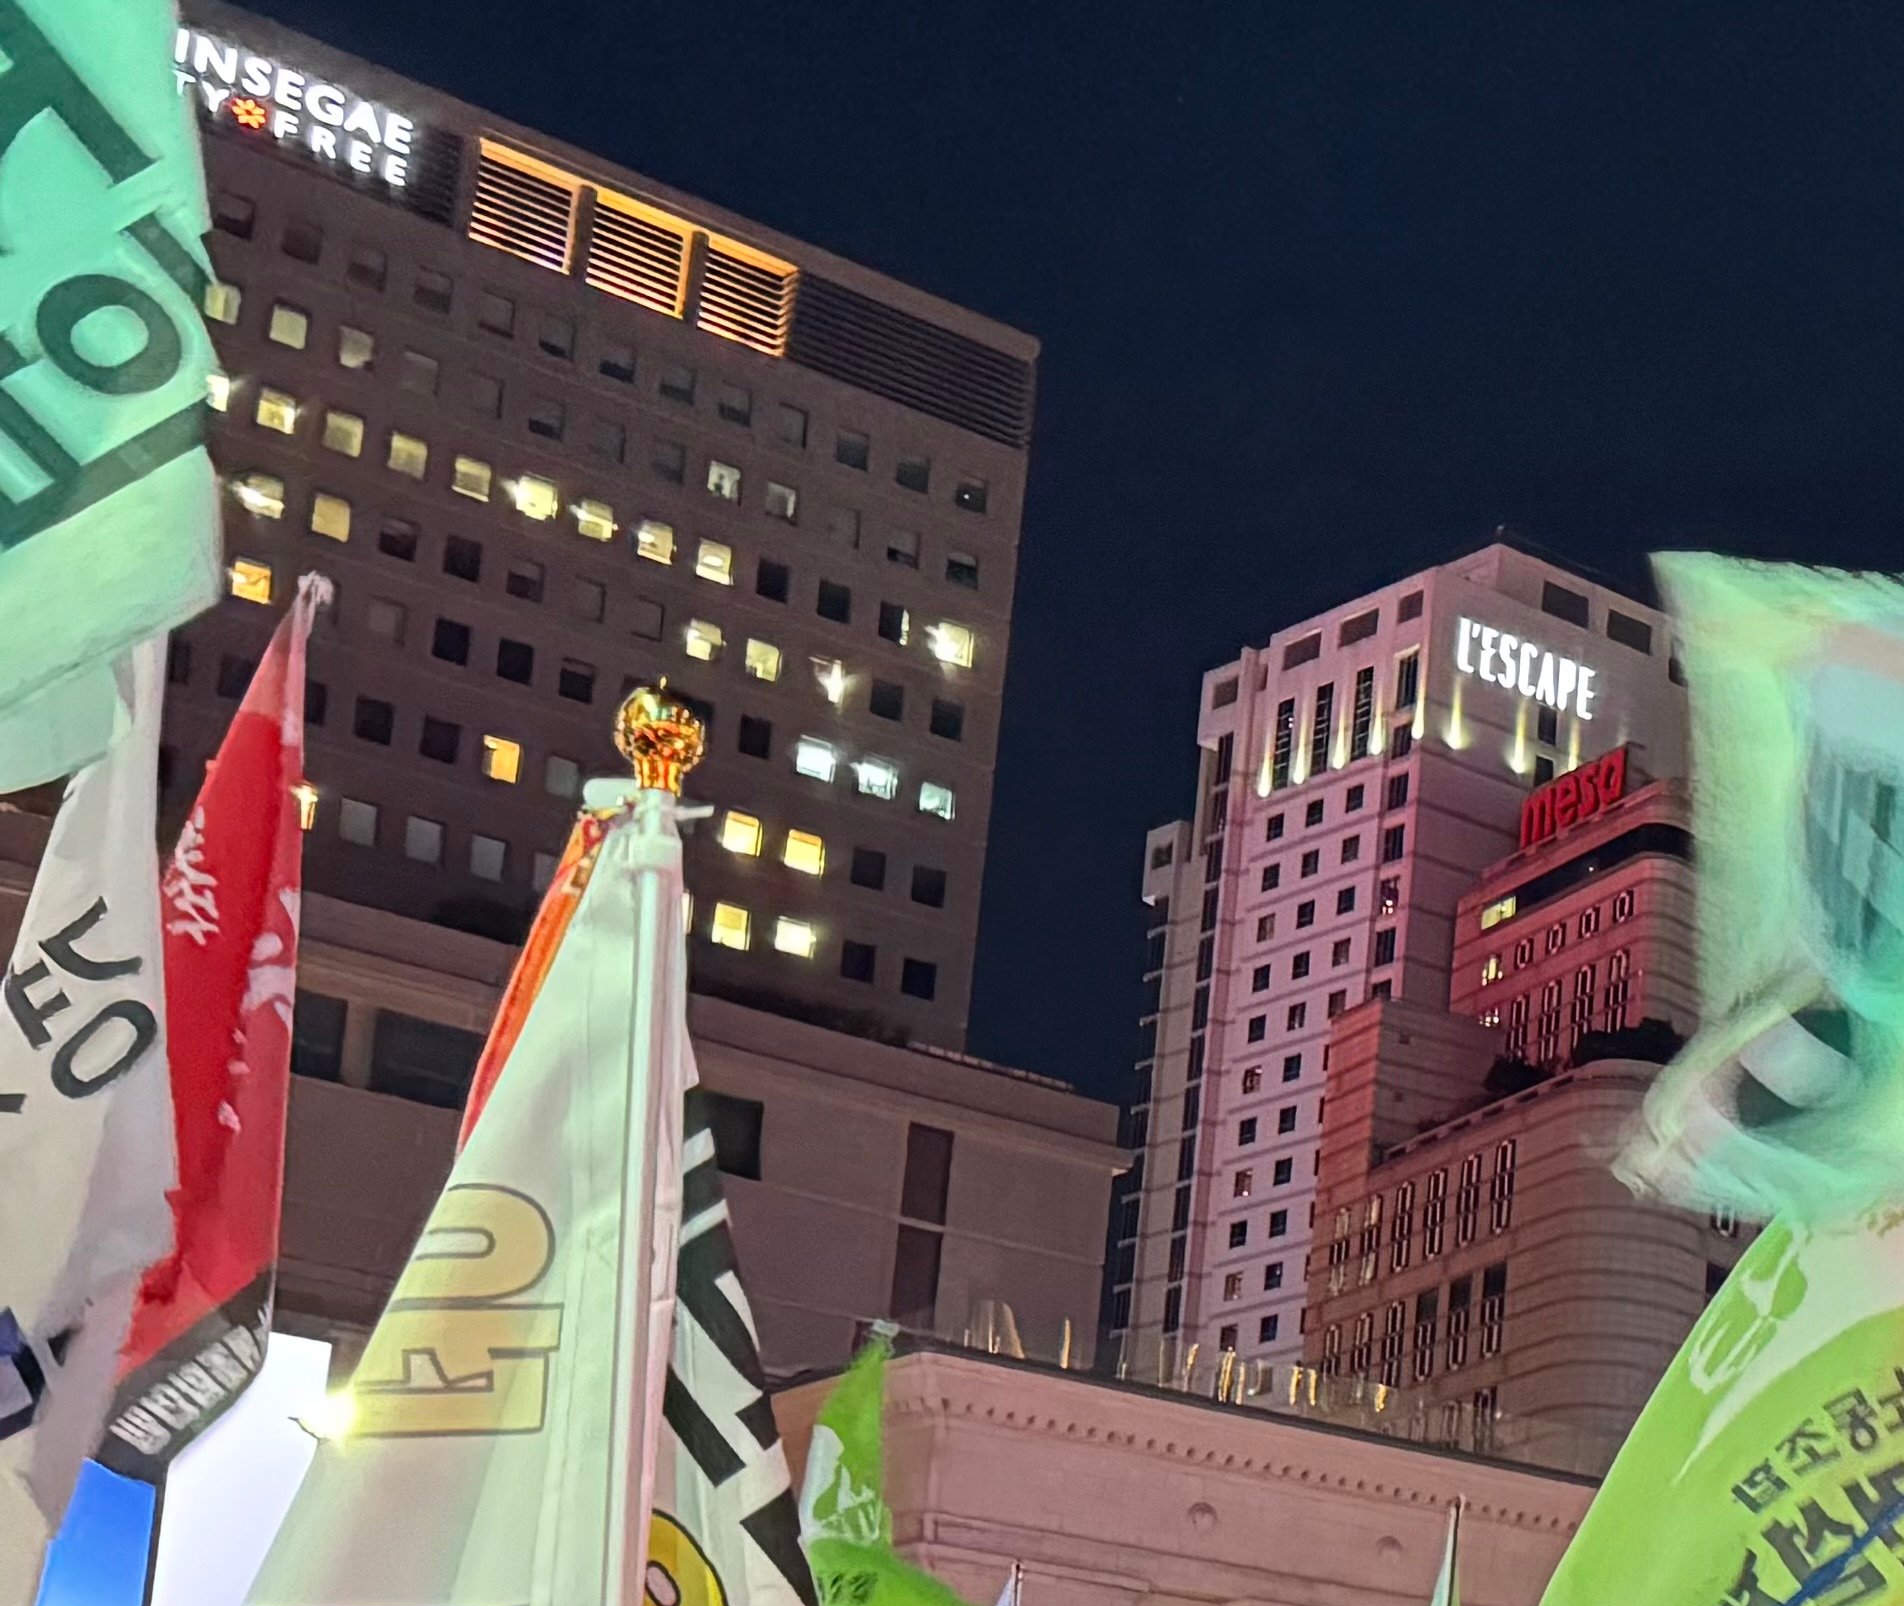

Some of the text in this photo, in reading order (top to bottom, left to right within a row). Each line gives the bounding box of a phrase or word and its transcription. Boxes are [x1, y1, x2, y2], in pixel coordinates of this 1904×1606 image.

[273, 110, 409, 186] FREE
[1457, 617, 1596, 720] L'ESCAPE
[1520, 748, 1627, 848] mesa
